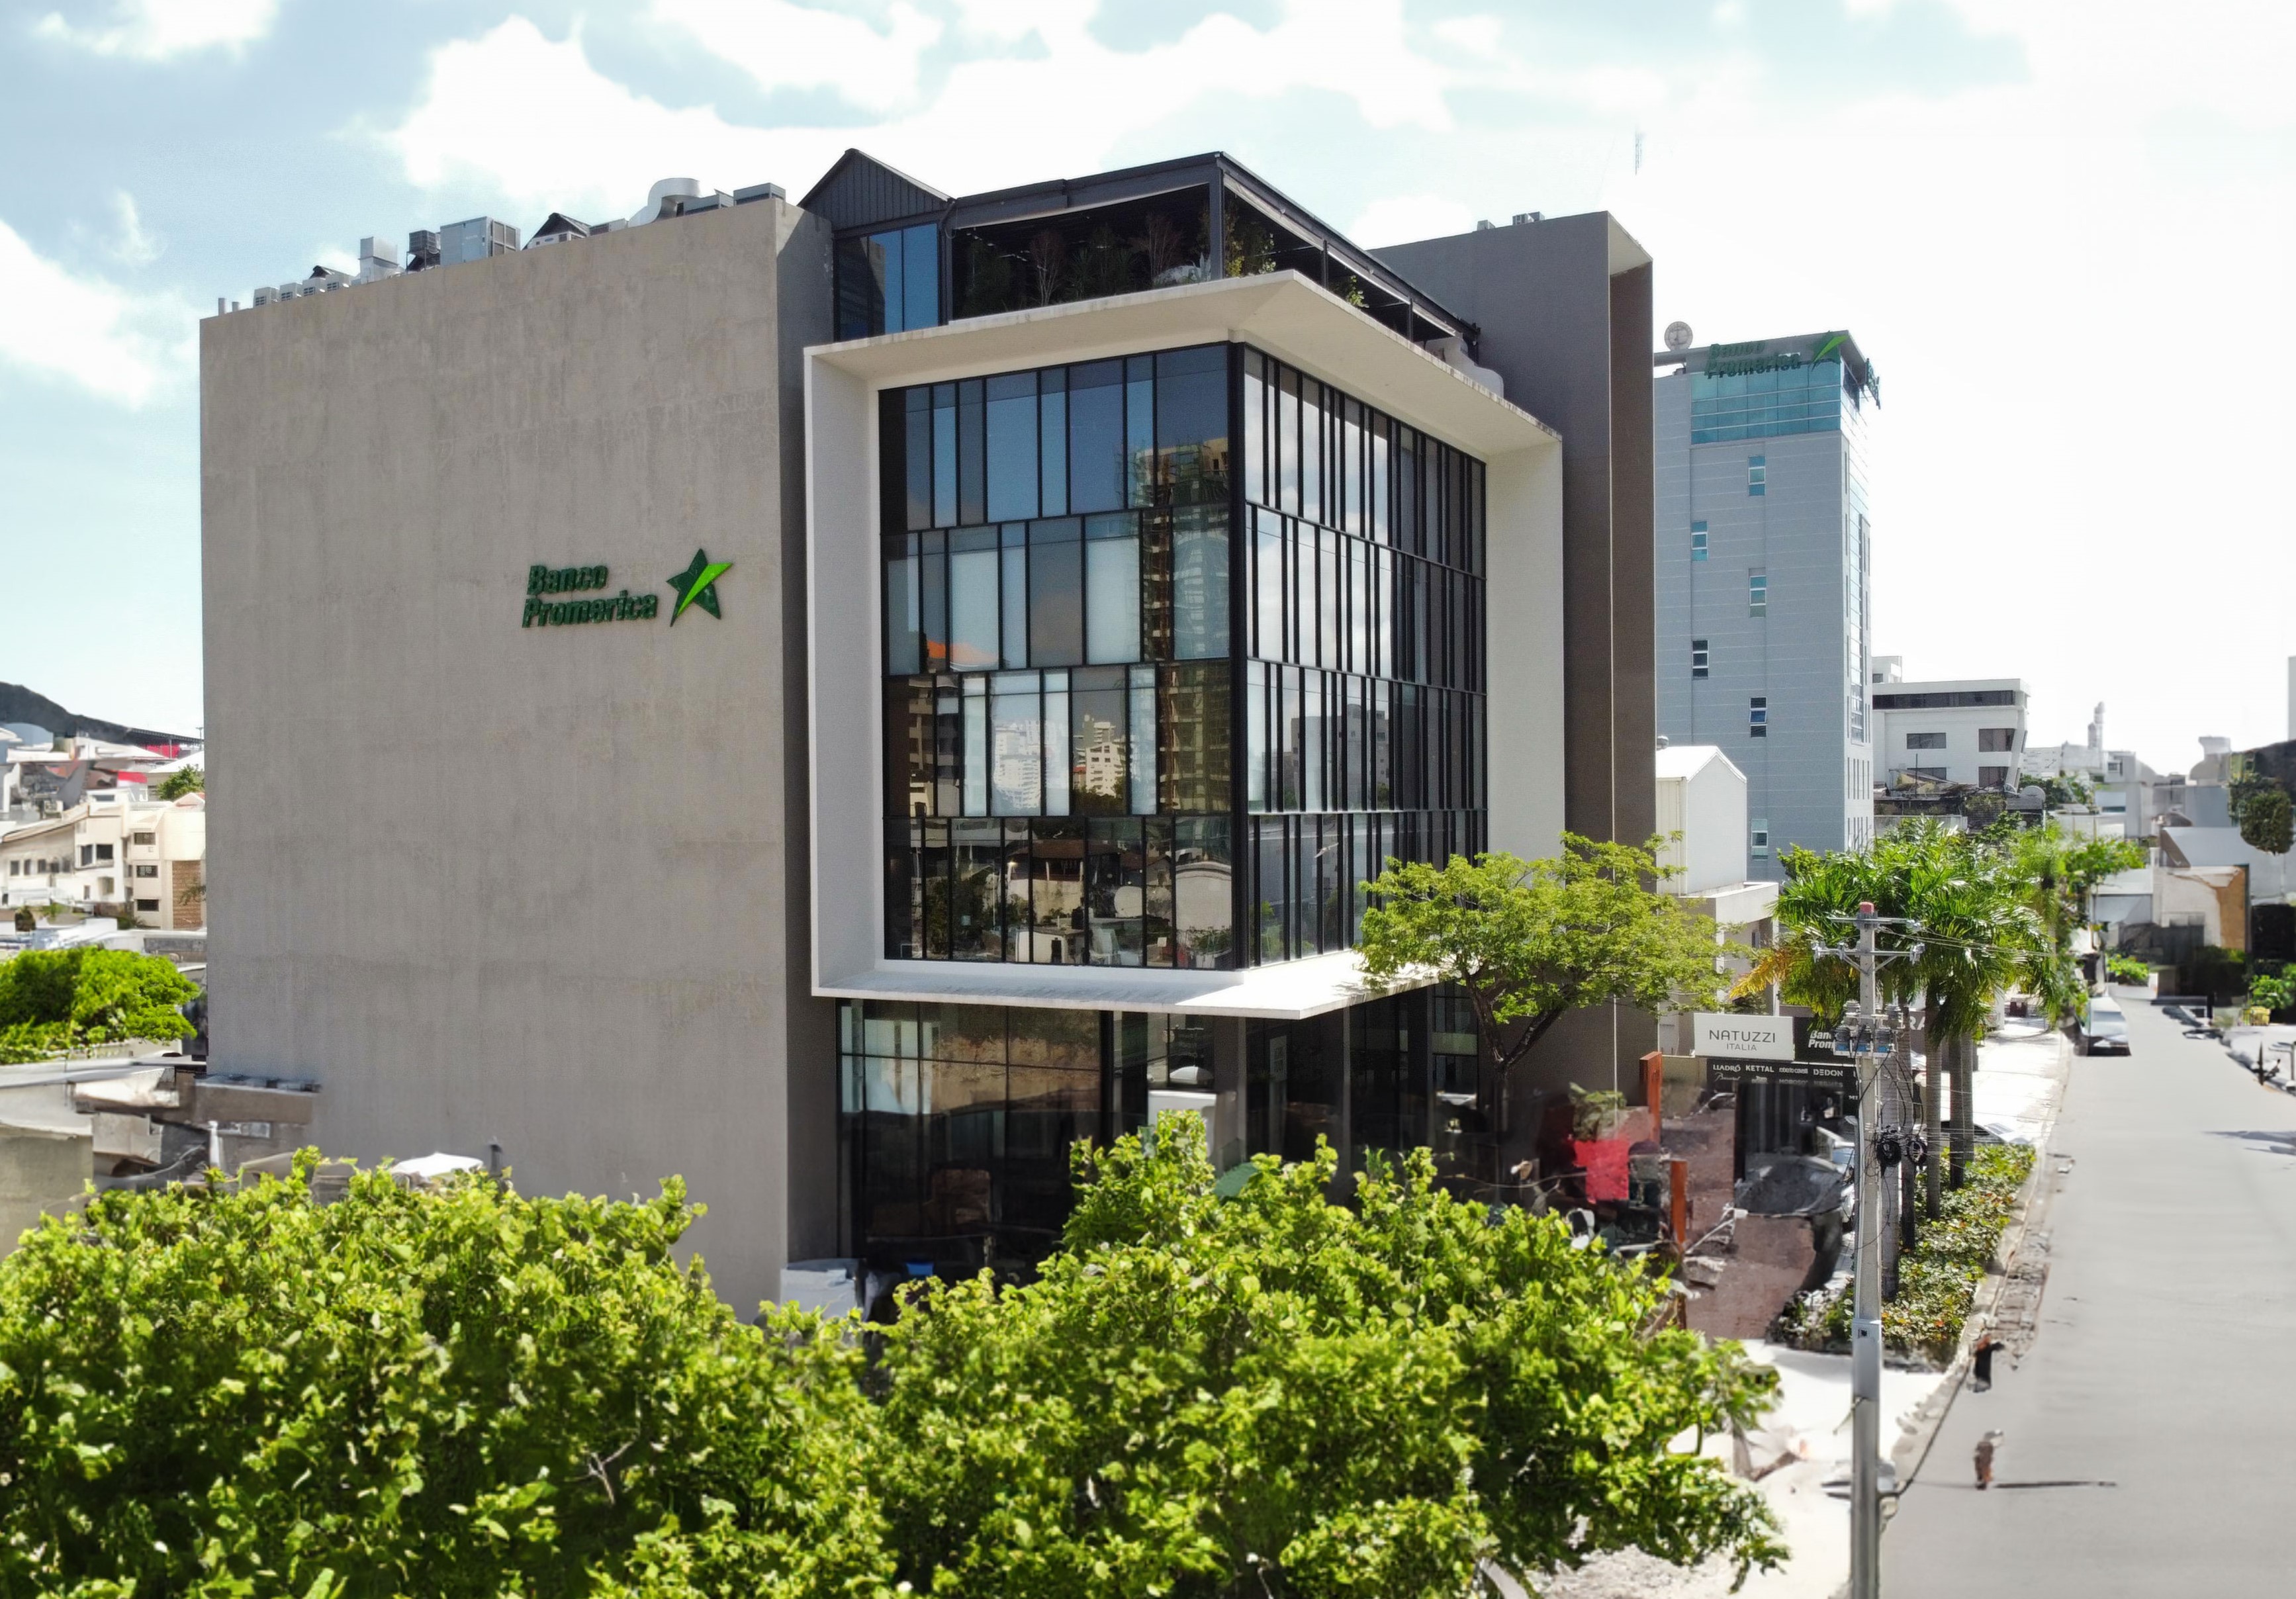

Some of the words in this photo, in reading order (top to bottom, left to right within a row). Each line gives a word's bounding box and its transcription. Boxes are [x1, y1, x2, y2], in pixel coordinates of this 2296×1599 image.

[527, 565, 609, 595] Banco
[522, 590, 657, 628] Promerica
[1709, 1029, 1775, 1043] NATUZZI
[1745, 1064, 1775, 1073] KETTAL
[1813, 1068, 1843, 1077] DEDON
